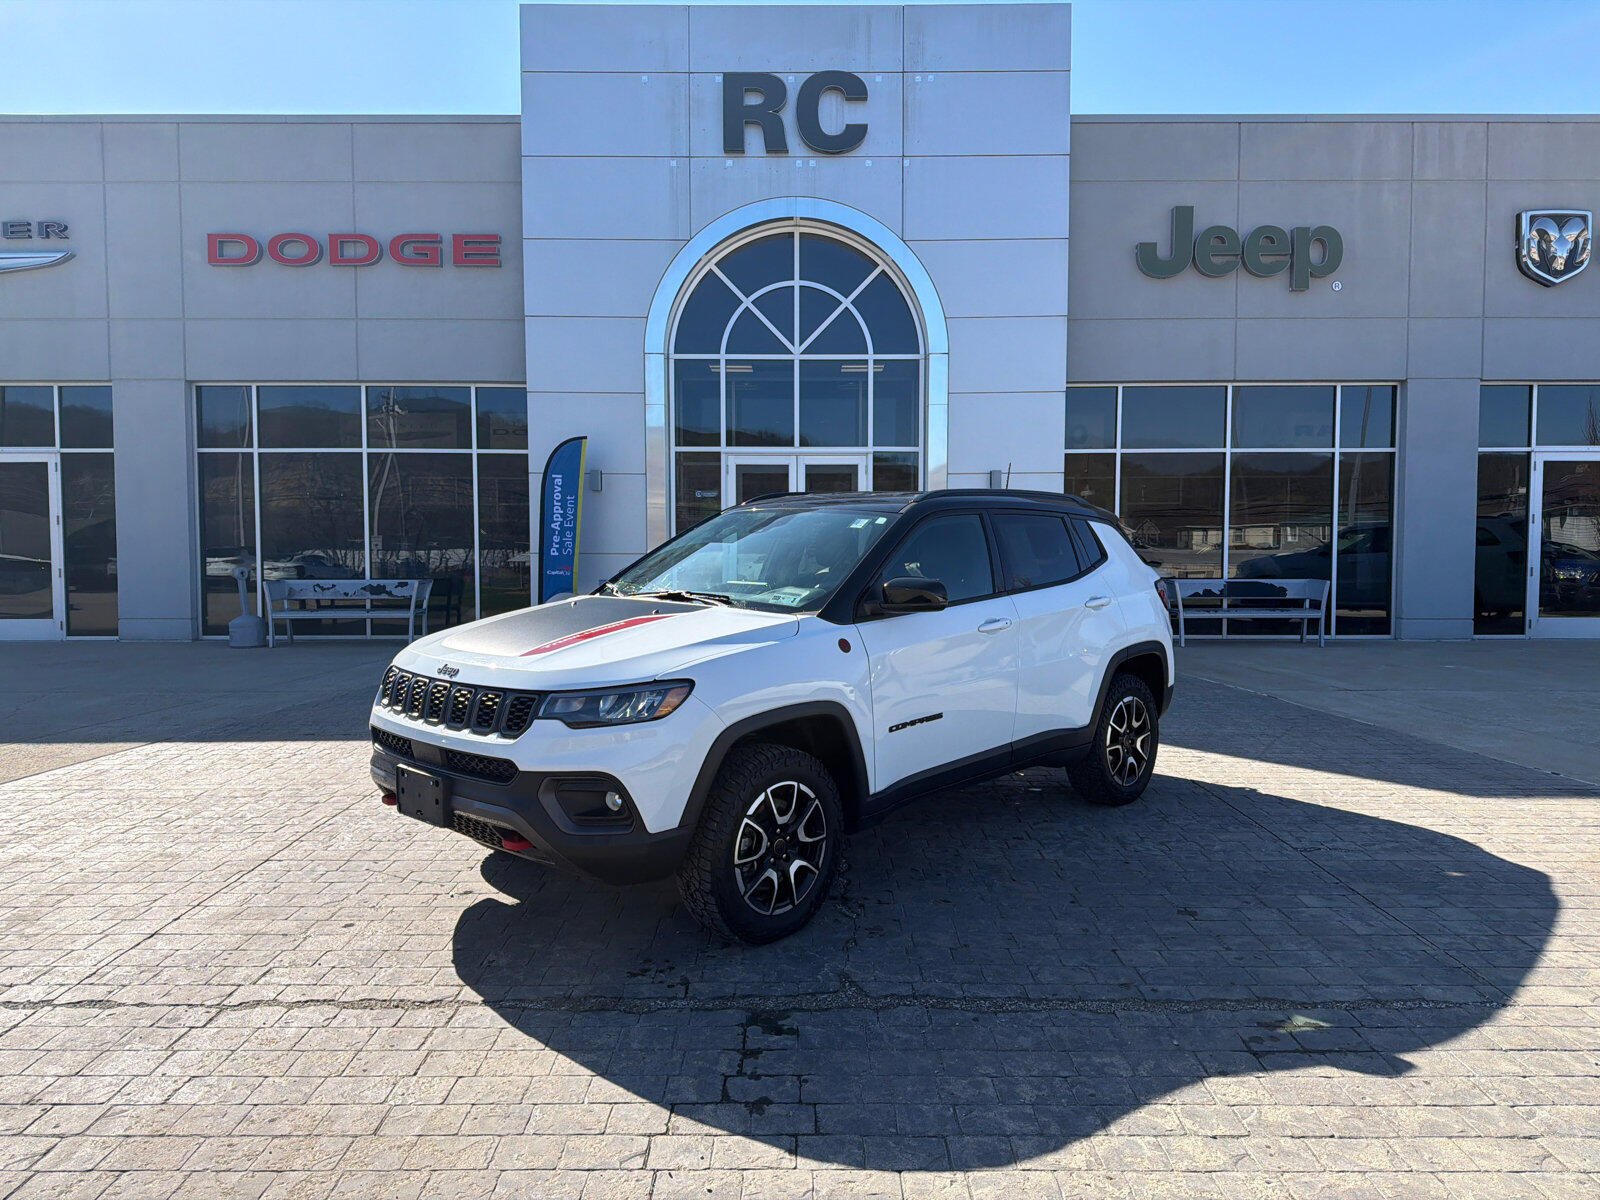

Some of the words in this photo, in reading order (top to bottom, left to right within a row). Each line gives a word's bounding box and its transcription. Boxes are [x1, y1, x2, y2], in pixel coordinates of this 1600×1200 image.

[723, 70, 868, 155] RC
[207, 233, 502, 267] DODGE
[1135, 205, 1344, 292] Jeep
[551, 474, 563, 556] Pre-Approval
[564, 496, 575, 527] Event
[563, 532, 573, 555] Sale
[437, 664, 459, 678] Jeep
[888, 712, 944, 733] COMPASS
